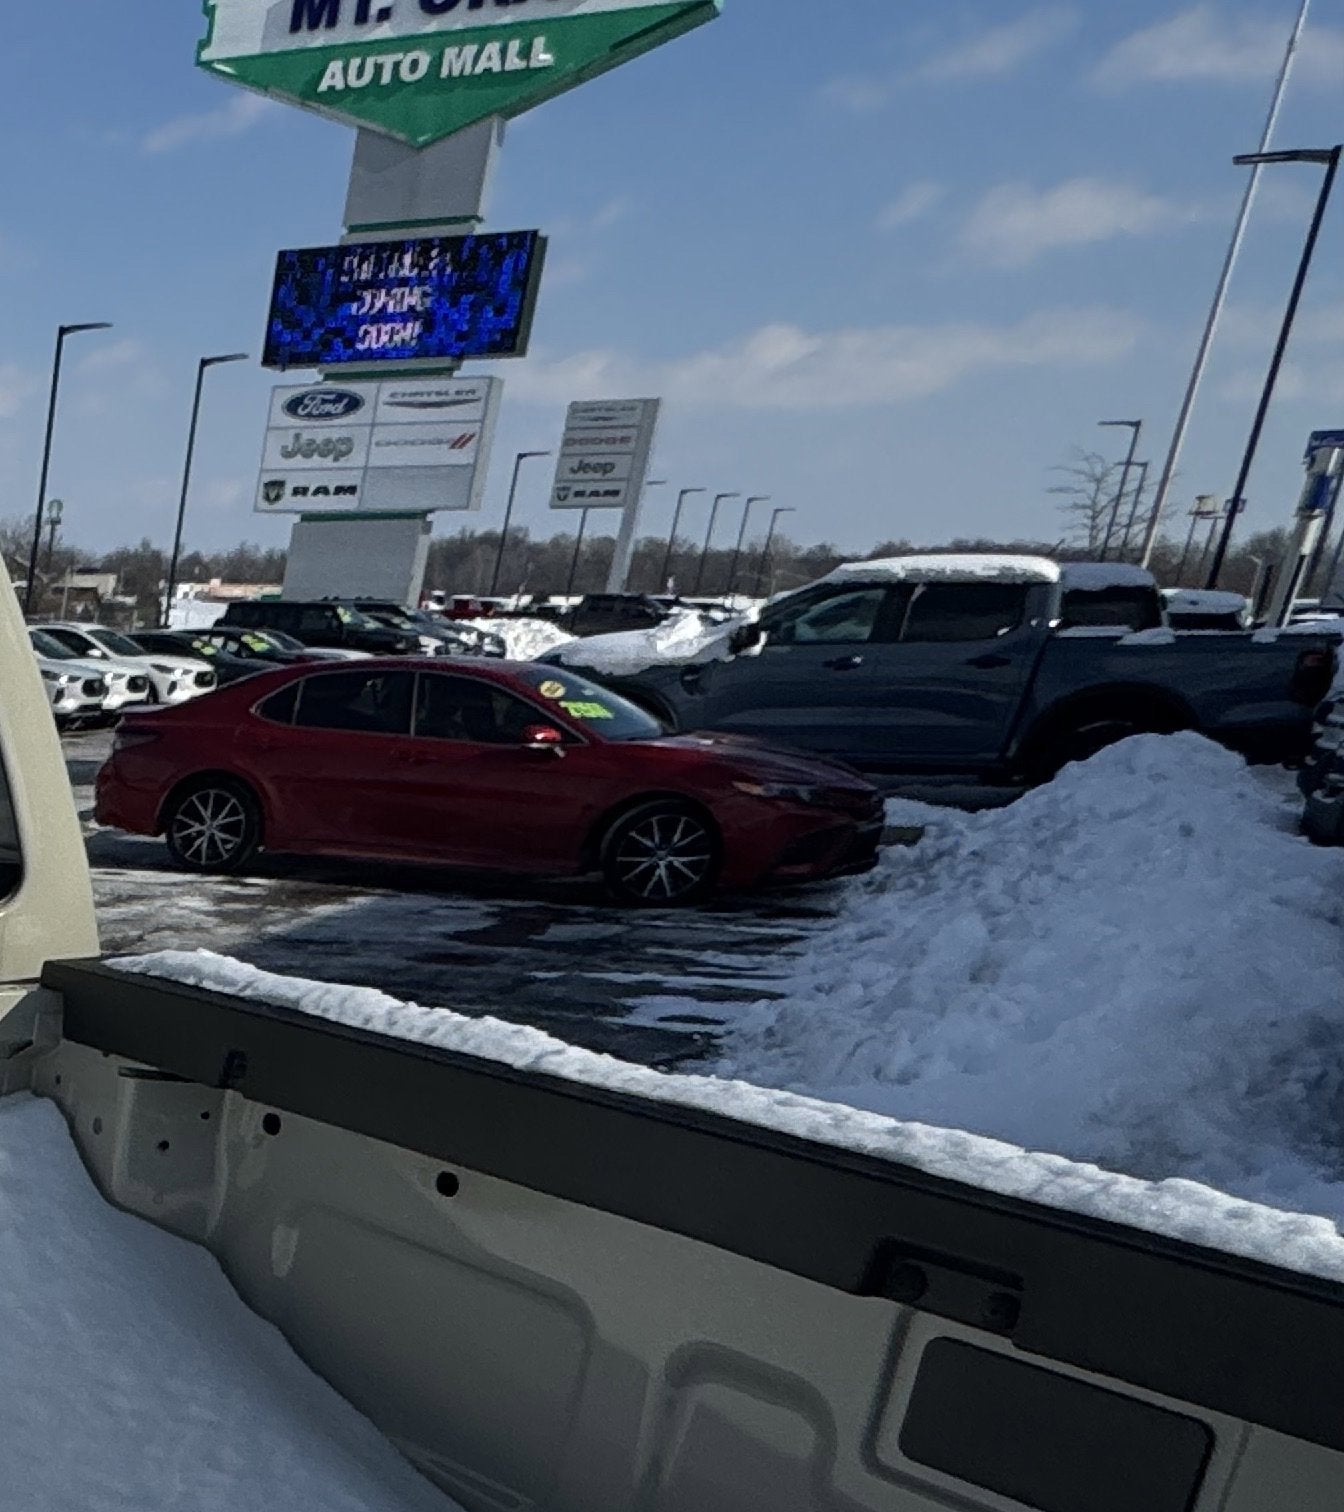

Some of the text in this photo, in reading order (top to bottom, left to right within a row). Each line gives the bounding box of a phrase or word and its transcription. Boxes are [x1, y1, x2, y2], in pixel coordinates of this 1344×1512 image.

[316, 36, 554, 93] AUTO MALL
[297, 393, 349, 417] Ford
[280, 432, 354, 462] Jeep
[569, 460, 616, 477] Jeep
[291, 484, 358, 497] RAM
[573, 489, 621, 498] RAM
